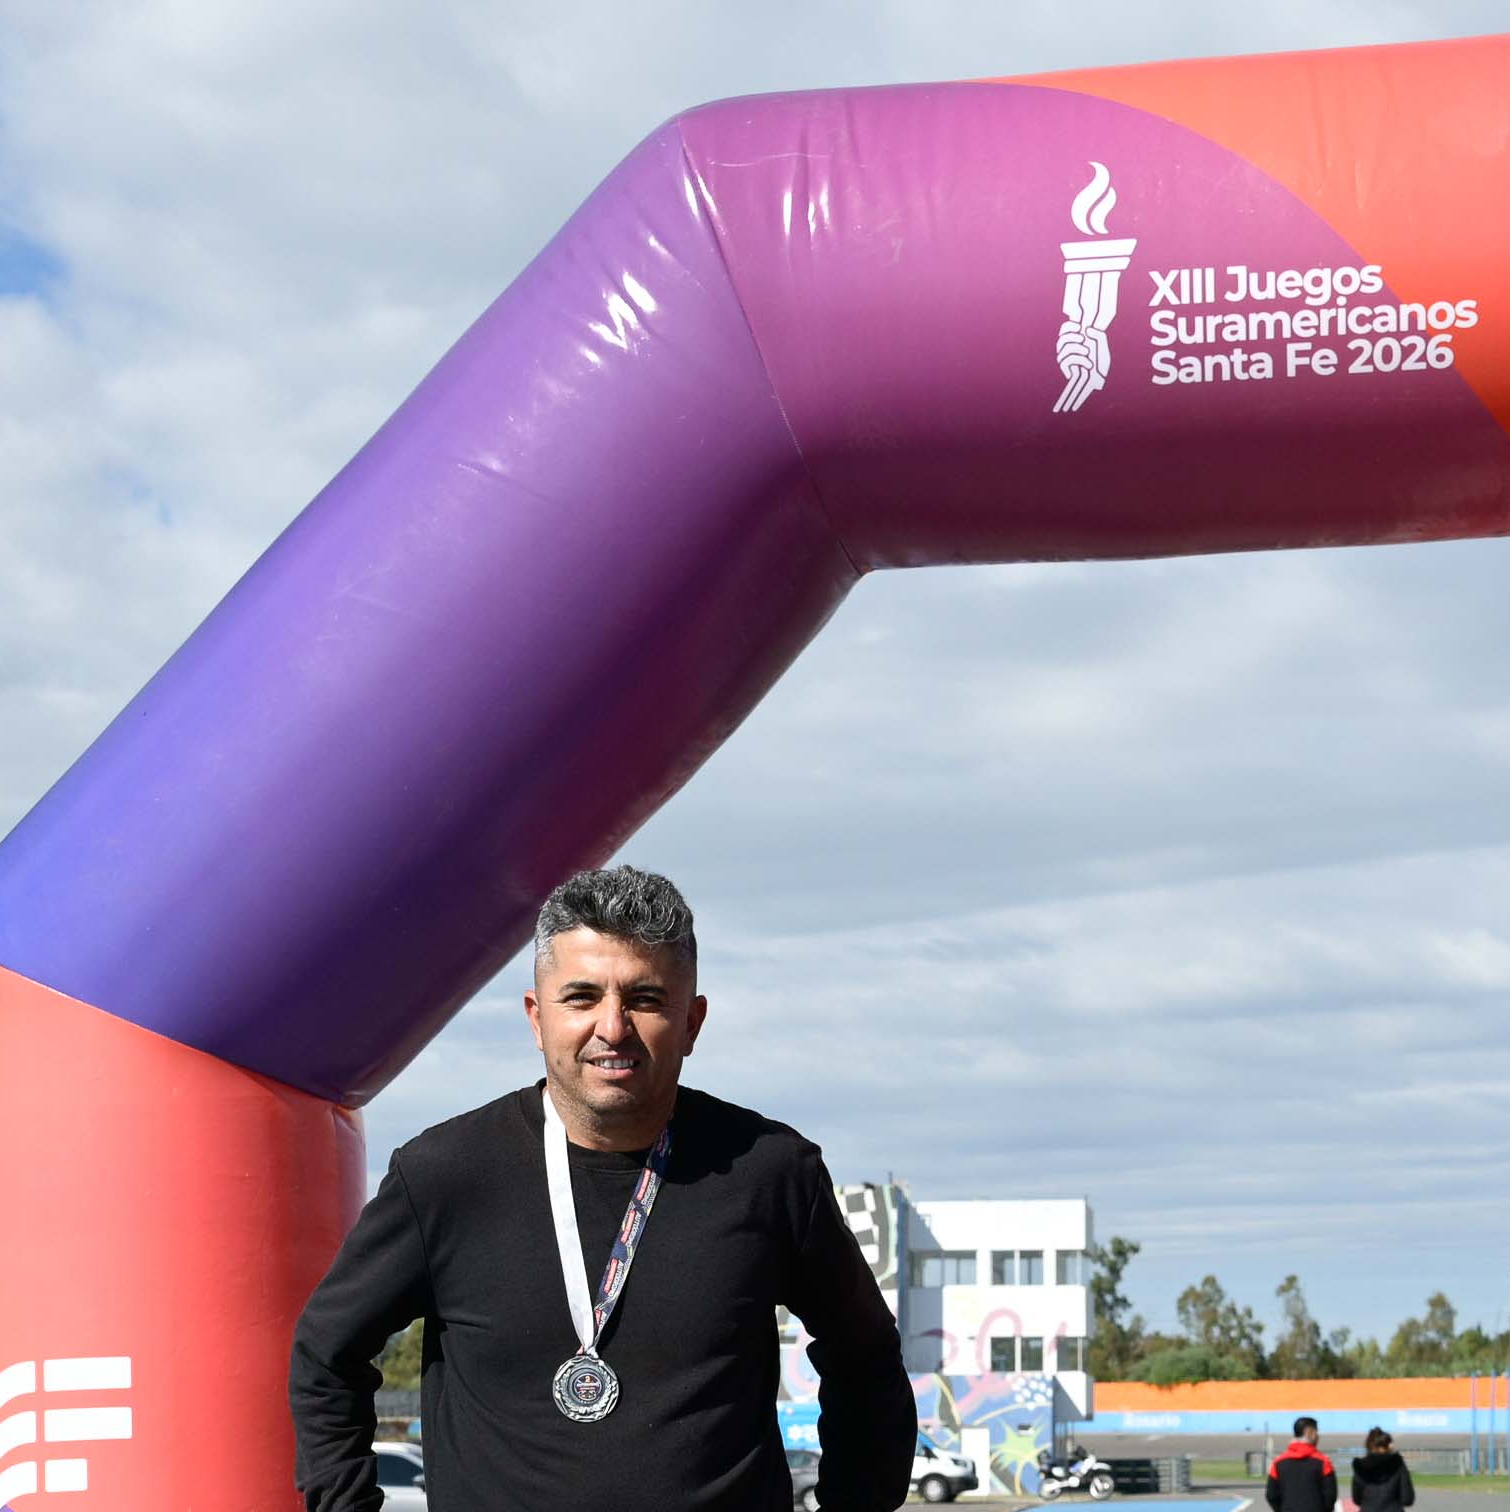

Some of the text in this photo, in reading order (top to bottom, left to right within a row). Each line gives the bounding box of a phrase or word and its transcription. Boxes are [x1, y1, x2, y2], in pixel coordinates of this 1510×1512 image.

[1148, 264, 1382, 306] XIII Juegos
[1151, 296, 1477, 345] Suramericanos
[1151, 335, 1454, 387] Santa Fe 2026
